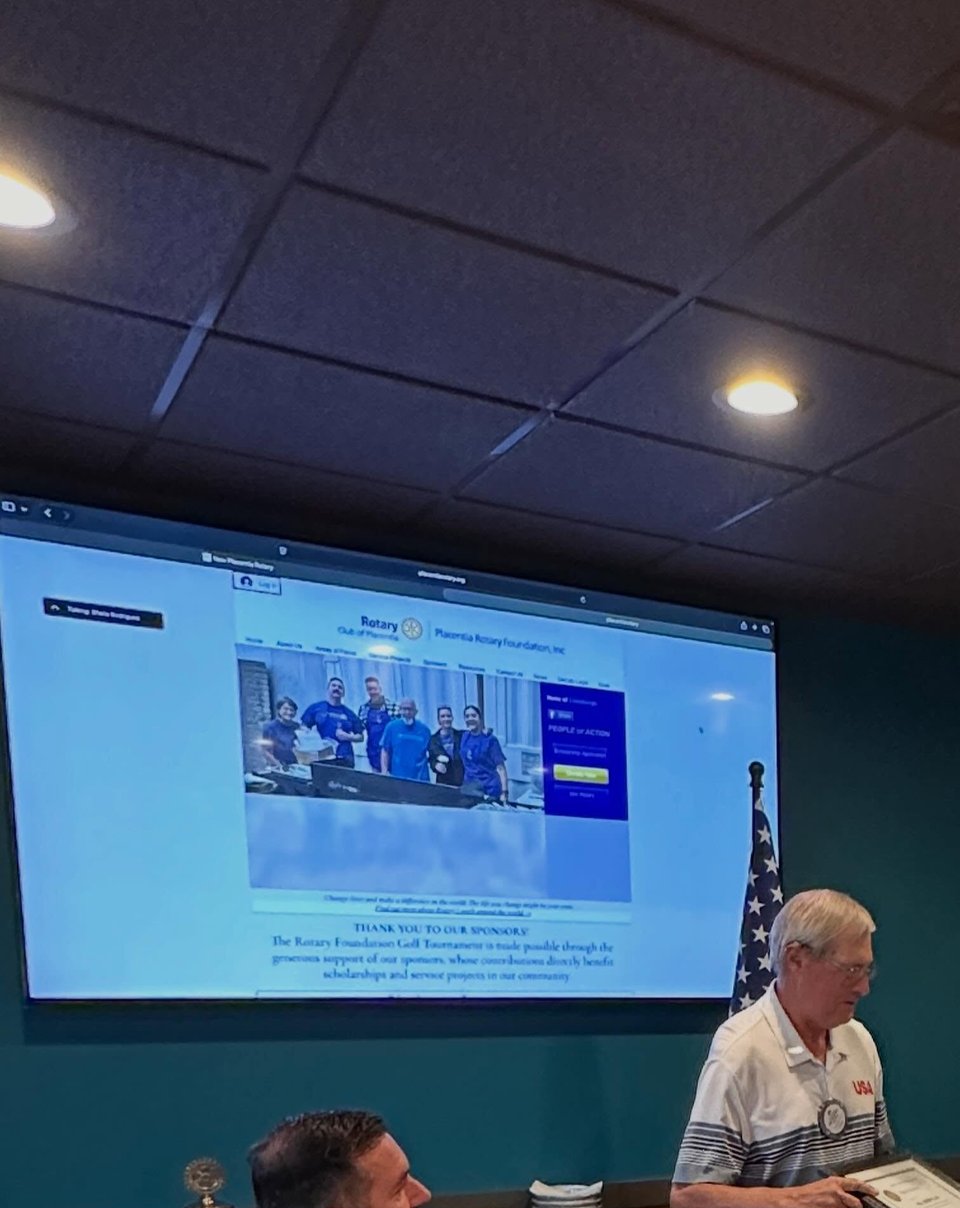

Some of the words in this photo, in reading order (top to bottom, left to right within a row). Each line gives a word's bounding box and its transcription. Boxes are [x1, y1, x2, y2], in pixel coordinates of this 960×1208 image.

[360, 616, 399, 633] Rotary
[435, 628, 474, 642] Placentia
[475, 633, 503, 648] Rotary
[354, 923, 394, 934] THANK
[398, 924, 423, 934] YOU
[426, 925, 442, 934] TO
[444, 926, 468, 935] OUR
[272, 936, 291, 947] The
[295, 936, 331, 949] Rotary
[335, 937, 395, 948] Foundation
[424, 939, 483, 950] Tournament
[486, 941, 494, 950] is
[496, 940, 521, 951] made
[523, 940, 561, 954] possible
[562, 940, 598, 955] through
[599, 941, 614, 952] the
[272, 955, 321, 966] generous
[323, 955, 364, 966] support
[367, 954, 378, 964] of
[380, 956, 397, 964] our
[448, 954, 479, 966] whose
[481, 954, 545, 966] contributions
[547, 955, 580, 969] directly
[582, 955, 614, 966] benefit
[323, 968, 387, 982] scholarships
[389, 970, 408, 980] and
[447, 971, 485, 985] projects
[488, 971, 498, 981] in
[500, 973, 516, 981] our
[852, 1081, 874, 1096] USA
